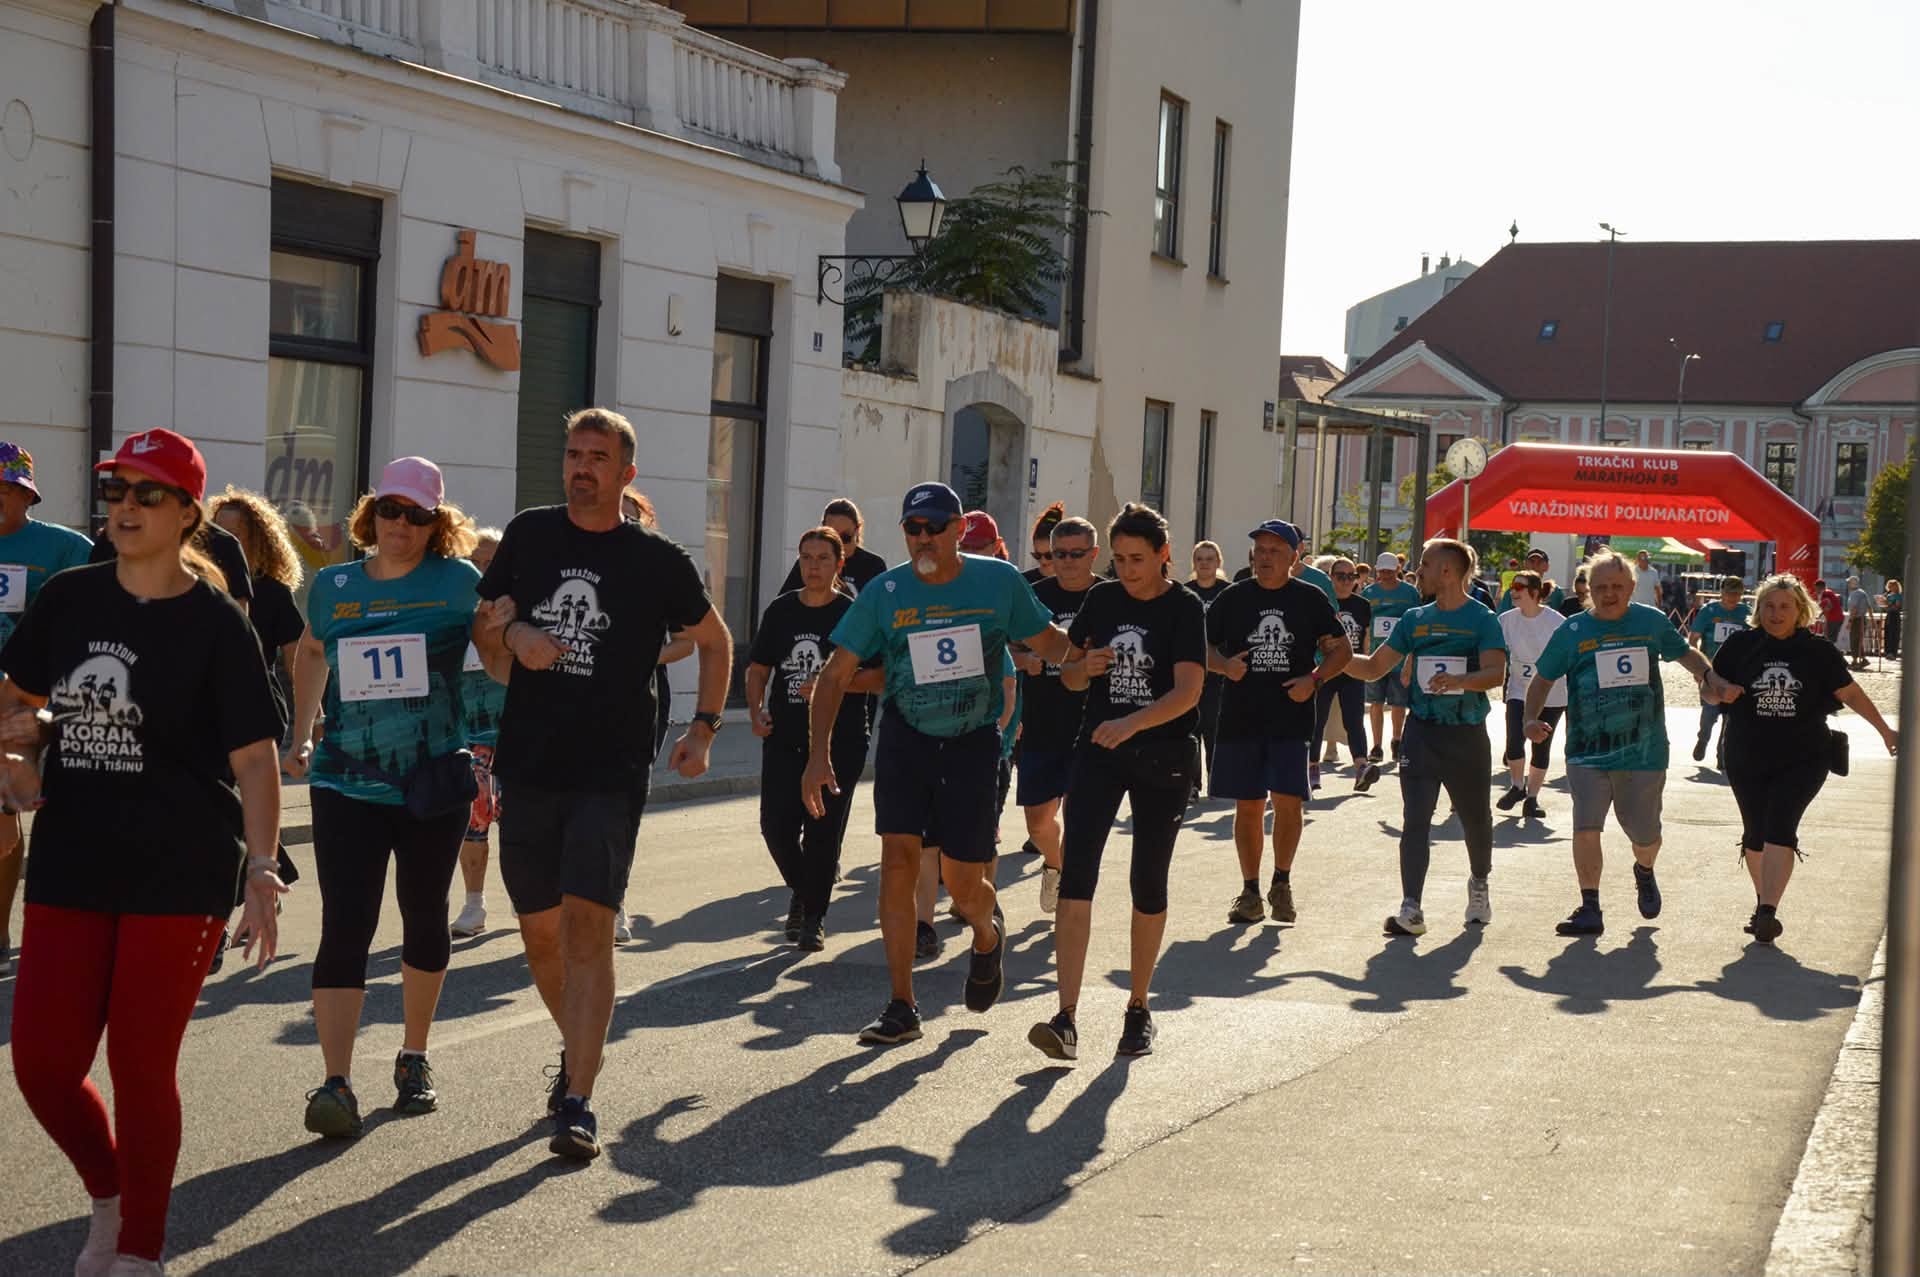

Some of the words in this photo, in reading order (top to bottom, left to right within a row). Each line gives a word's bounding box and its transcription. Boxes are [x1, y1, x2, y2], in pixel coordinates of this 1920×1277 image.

[441, 230, 510, 317] dm
[1577, 454, 1635, 469] TRKAČKI
[1643, 458, 1679, 470] KLUB
[264, 432, 334, 514] dm
[1574, 469, 1657, 486] MARATHON
[1662, 473, 1679, 486] 95
[1509, 499, 1609, 519] VARAŽDINSKI
[1616, 505, 1730, 523] POLUMARATON
[560, 568, 601, 584] VARAŽDIN
[1383, 621, 1391, 631] 9
[88, 641, 138, 665] VARAŽDIN
[937, 638, 958, 665] 8
[1253, 651, 1287, 659] KORAK
[362, 646, 404, 680] 11
[564, 664, 593, 676] TIŠINU
[1617, 655, 1632, 675] 6
[1758, 696, 1794, 705] KORAK
[62, 723, 137, 743] KORAK
[60, 739, 81, 753] PO
[83, 741, 143, 757] KORAK
[104, 760, 144, 773] TIŠINU
